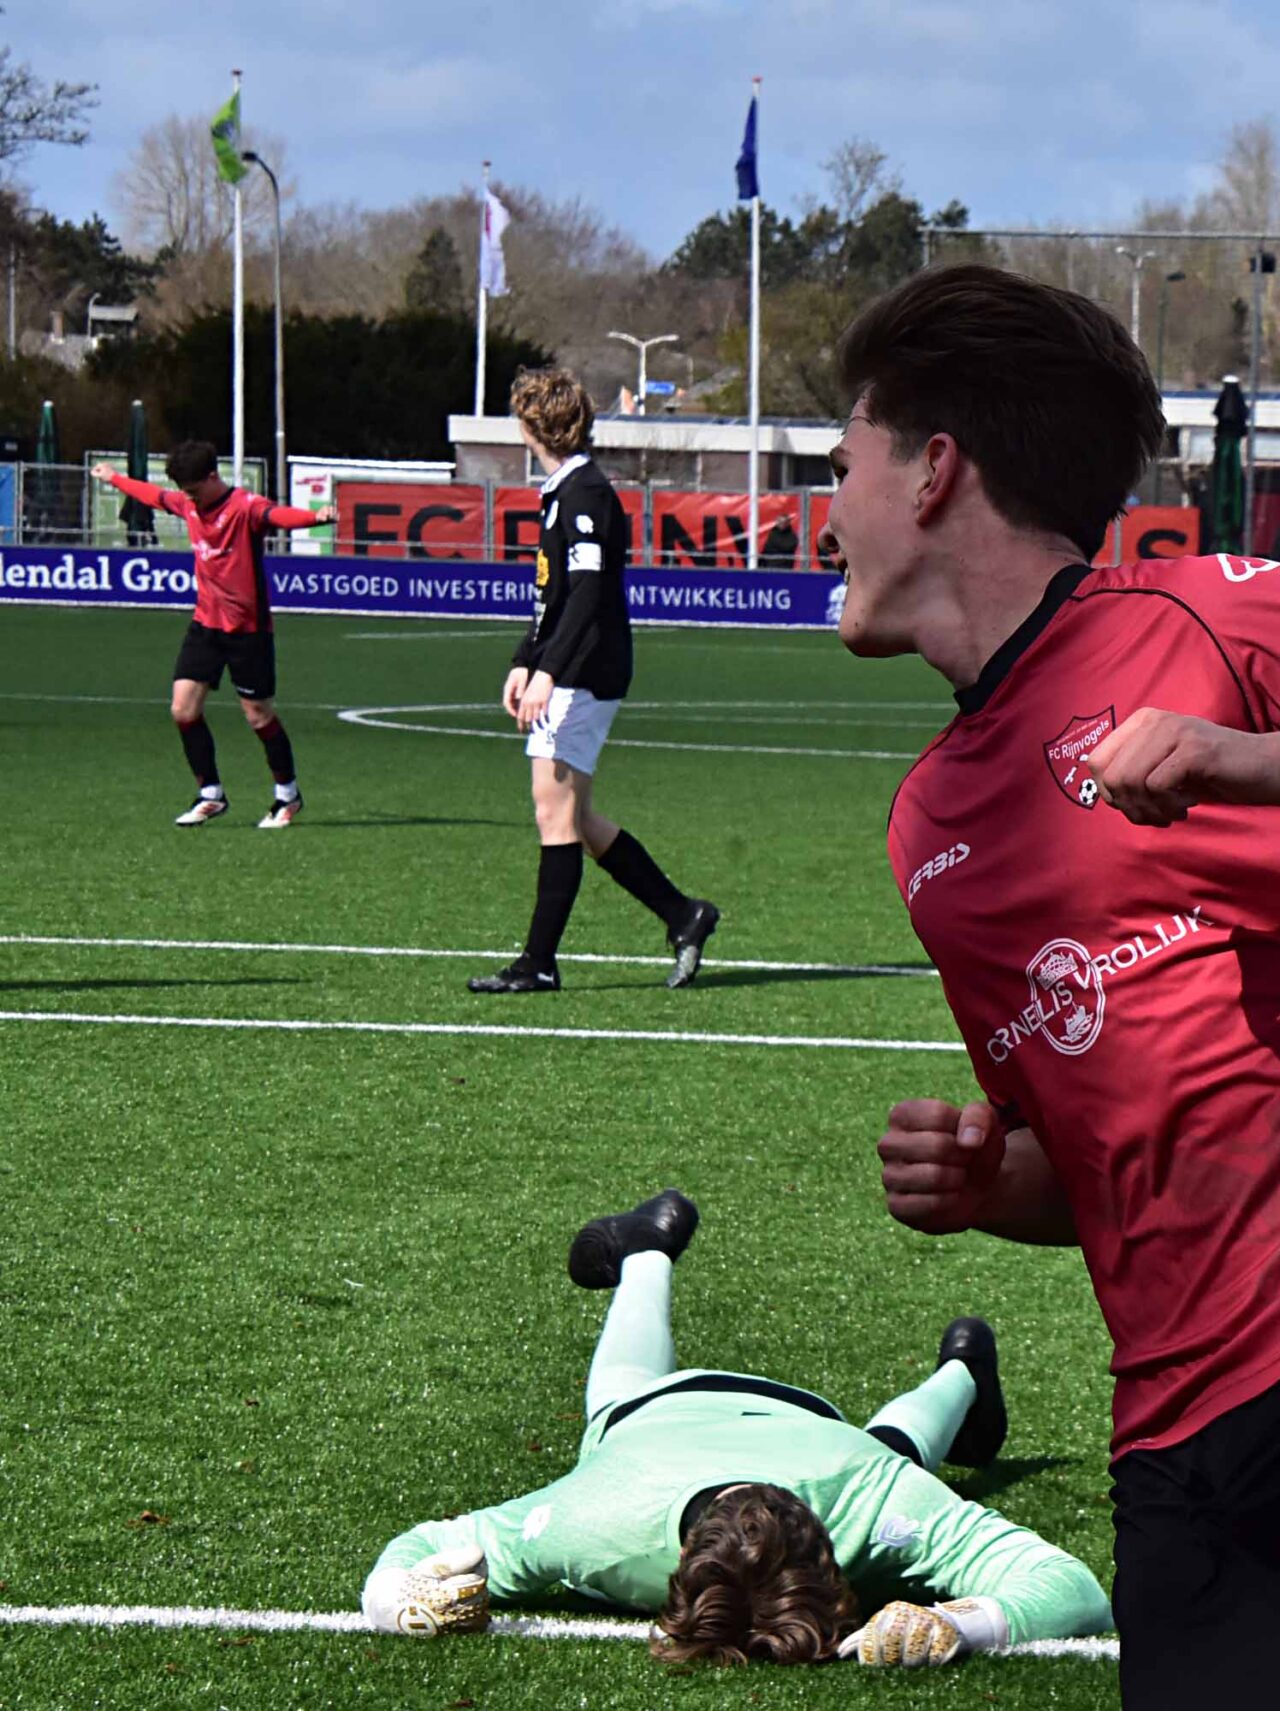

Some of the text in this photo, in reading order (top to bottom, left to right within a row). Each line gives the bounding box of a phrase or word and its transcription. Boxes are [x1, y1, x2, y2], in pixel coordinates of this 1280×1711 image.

[354, 503, 464, 558] FC
[121, 557, 198, 593] Gro
[273, 573, 791, 609] VASTGOED INVESTERIN NTWIKKELING
[1048, 747, 1061, 760] FC
[1061, 719, 1110, 760] Rijnvogels
[986, 905, 1214, 1066] ORNELIS VROLIJK
